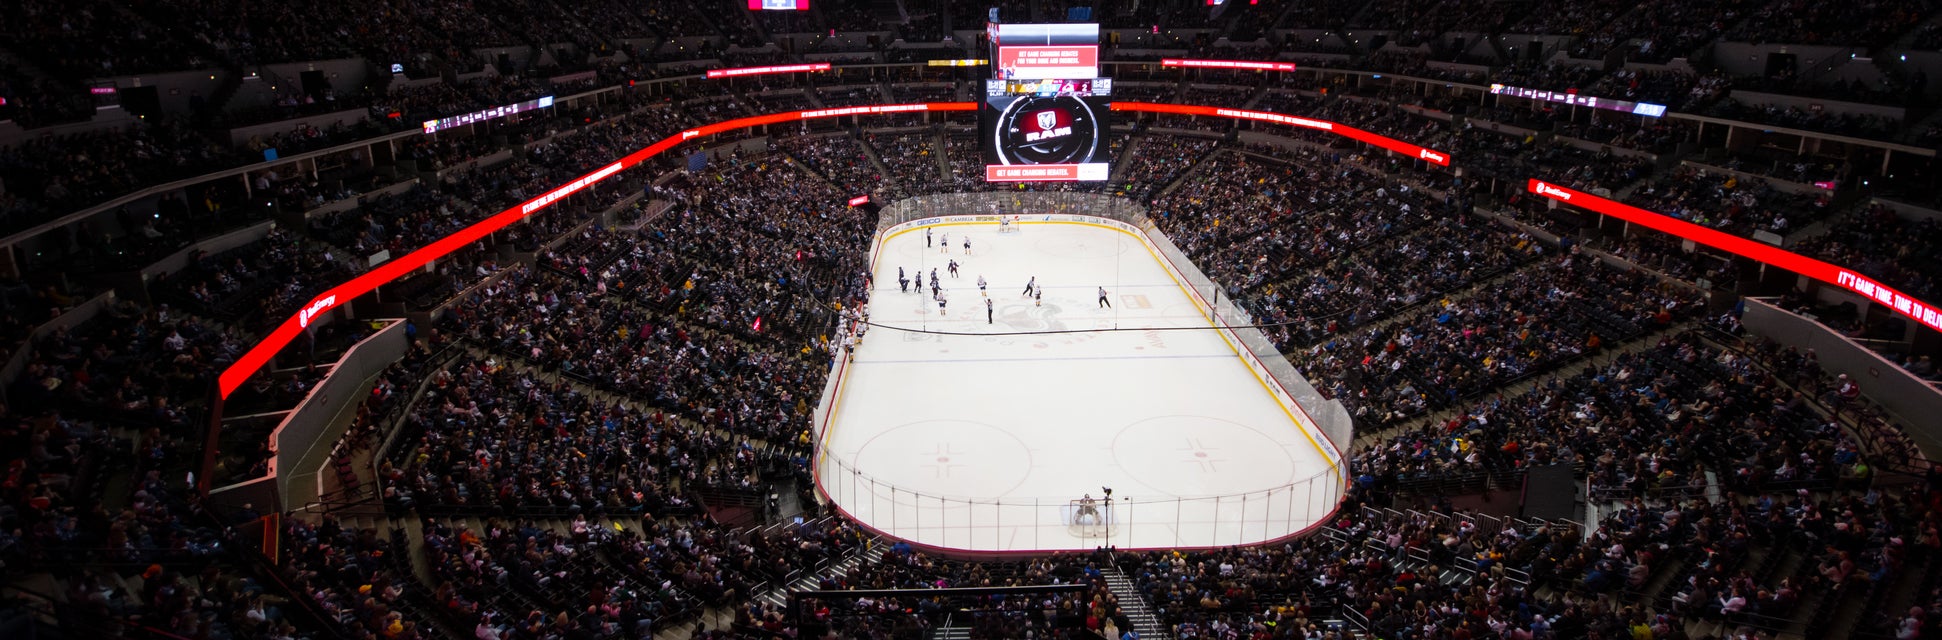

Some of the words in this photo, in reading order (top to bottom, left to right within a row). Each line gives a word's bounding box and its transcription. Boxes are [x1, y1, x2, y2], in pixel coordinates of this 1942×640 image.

[1026, 126, 1072, 142] RAM
[996, 169, 1006, 177] GET
[917, 218, 940, 226] GEICO
[1838, 271, 1856, 287] IT'S
[1855, 277, 1875, 297] GAME
[1875, 286, 1893, 306] TIME.
[1894, 294, 1912, 314] TIME
[1912, 302, 1923, 319] TO
